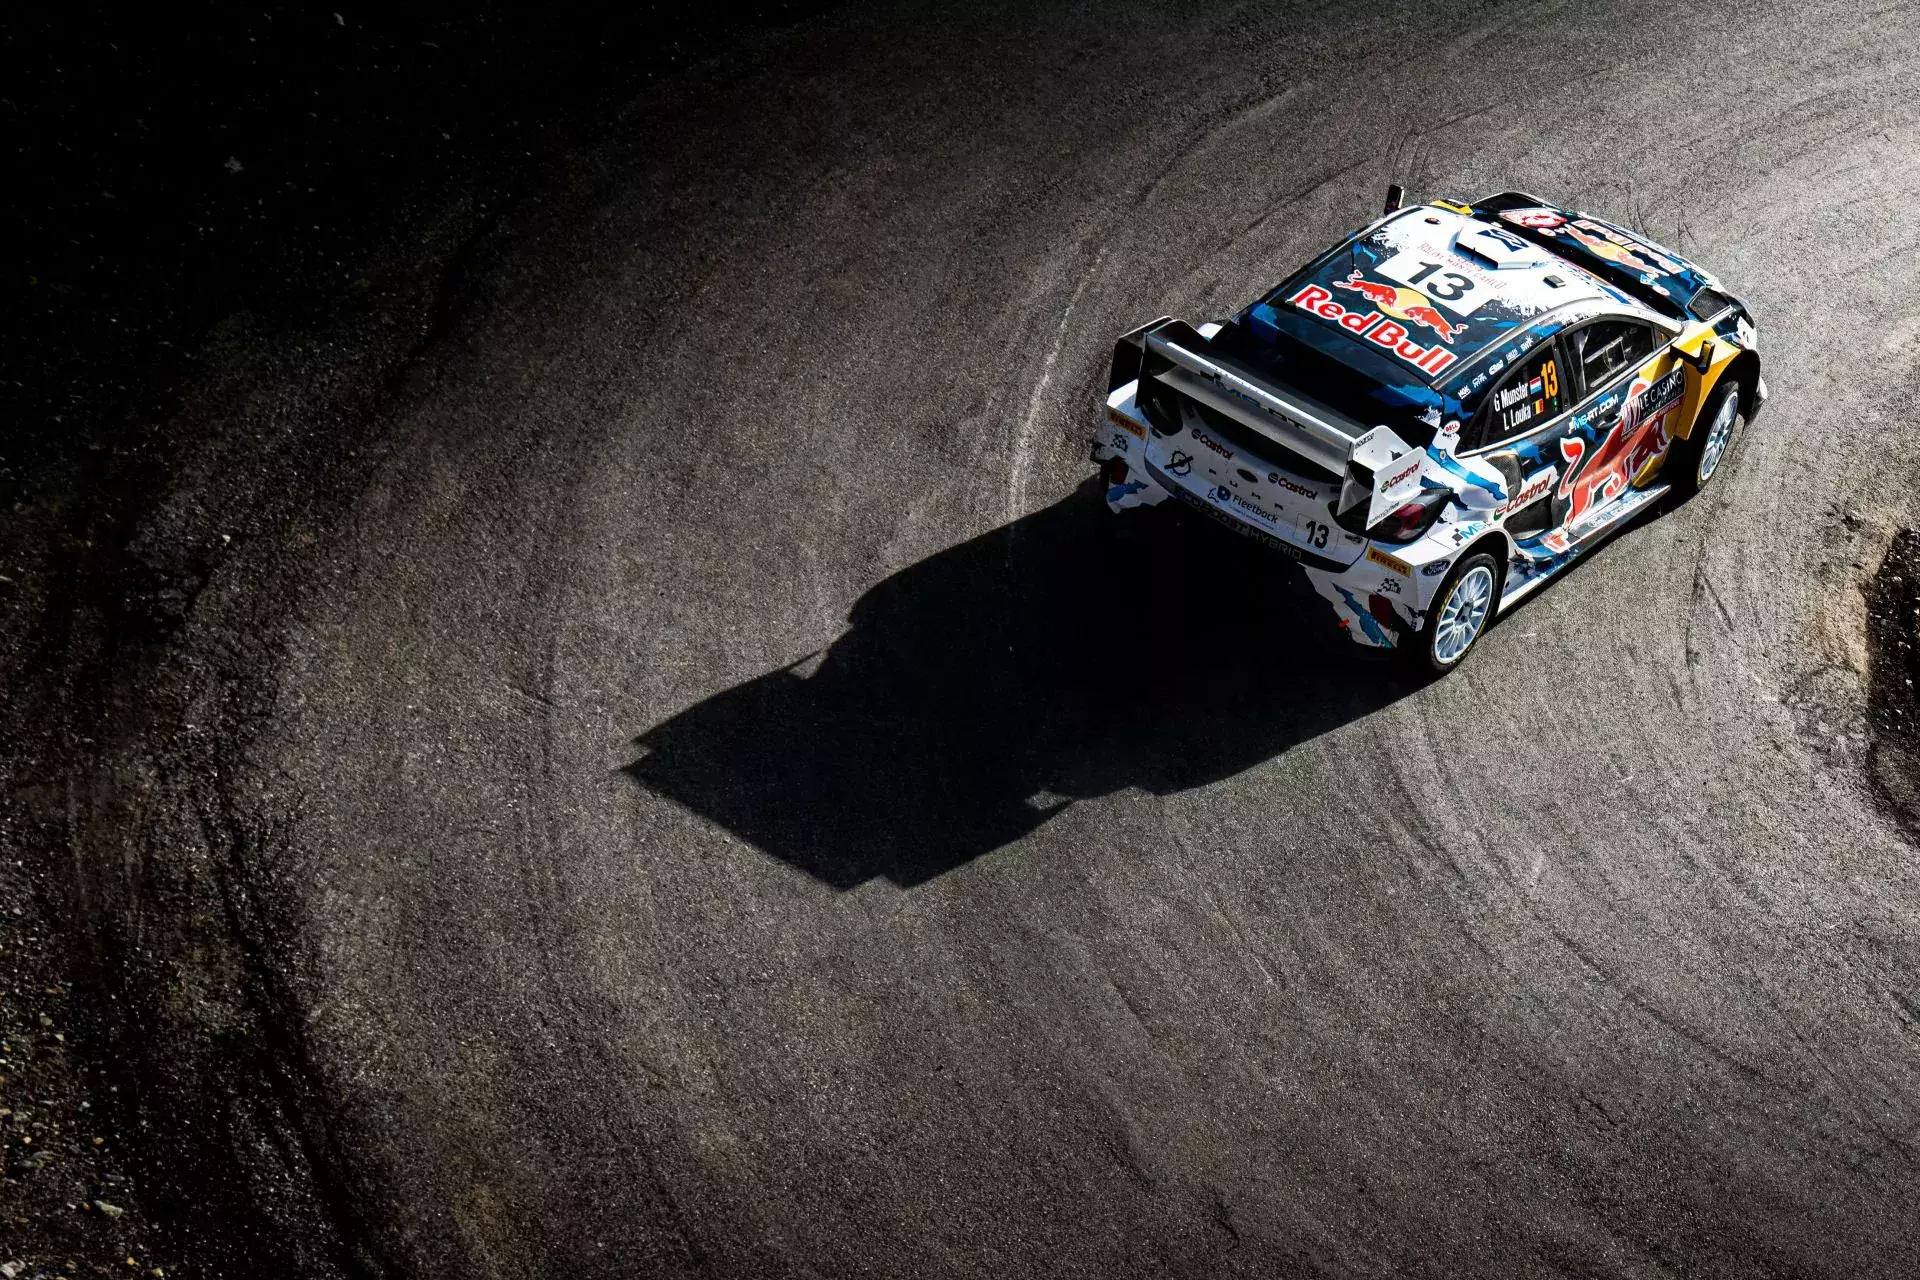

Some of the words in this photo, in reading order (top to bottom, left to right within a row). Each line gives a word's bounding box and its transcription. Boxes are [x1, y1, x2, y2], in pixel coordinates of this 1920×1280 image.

[1406, 261, 1475, 301] 13
[1285, 283, 1381, 335] Red
[1365, 319, 1459, 377] Bull
[1540, 360, 1558, 399] 13
[1650, 371, 1683, 402] CASINO
[1494, 393, 1501, 412] G
[1500, 381, 1529, 409] Munster
[1503, 413, 1510, 431] L
[1510, 403, 1532, 427] Louka
[1200, 434, 1234, 461] Castrol
[1278, 478, 1319, 500] Castrol
[1389, 459, 1421, 488] Castrol
[1506, 474, 1551, 513] Castrol
[1232, 494, 1279, 525] Fleetback
[1306, 520, 1330, 549] 13
